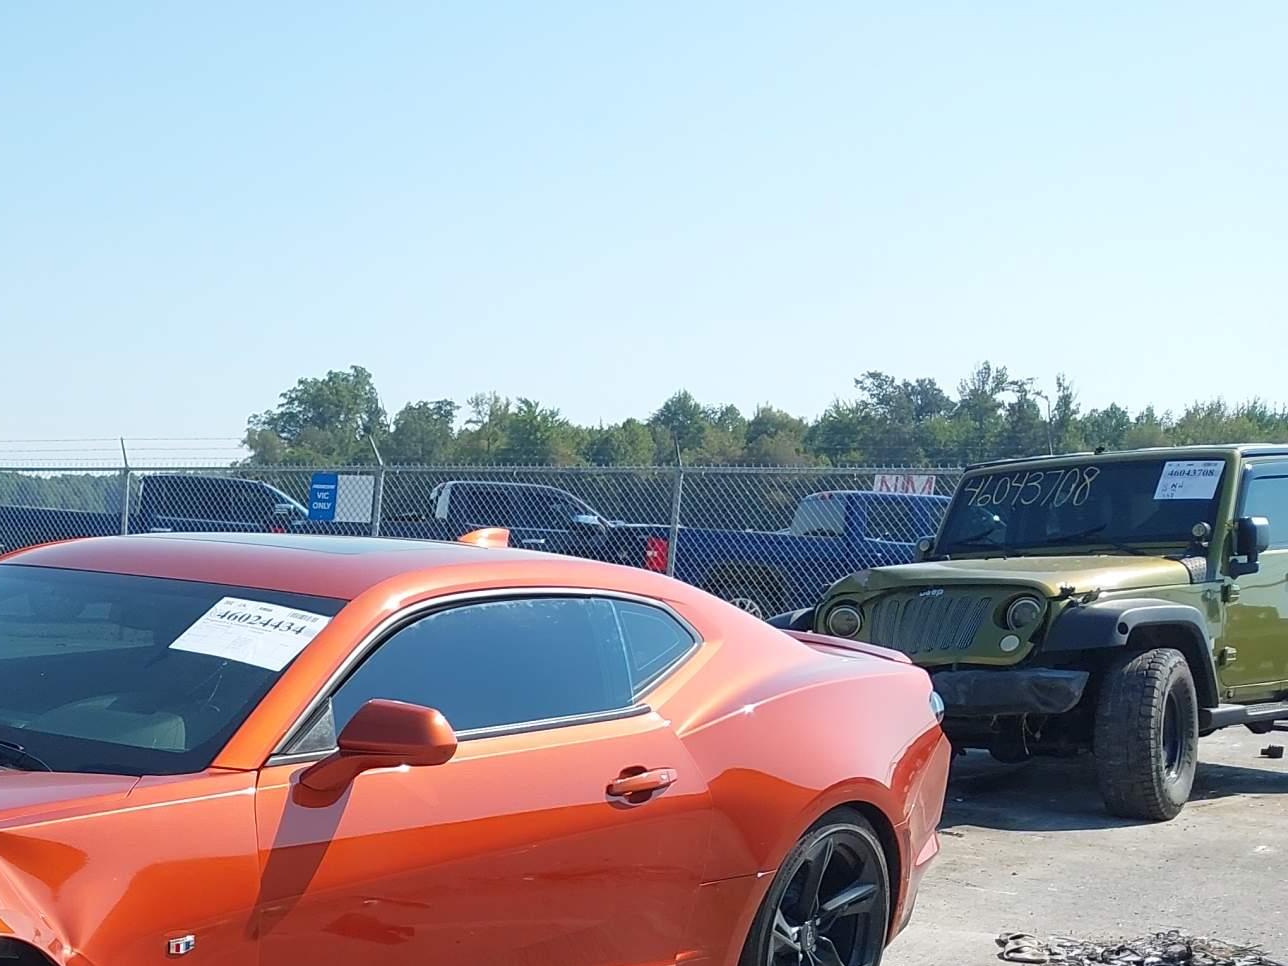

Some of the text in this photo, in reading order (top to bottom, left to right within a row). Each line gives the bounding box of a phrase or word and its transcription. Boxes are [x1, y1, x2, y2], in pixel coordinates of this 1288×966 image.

[1167, 468, 1215, 477] 46043708
[964, 466, 1100, 508] 46043708
[316, 491, 330, 500] VIC
[312, 502, 332, 510] ONLY
[216, 610, 308, 636] 46024434
